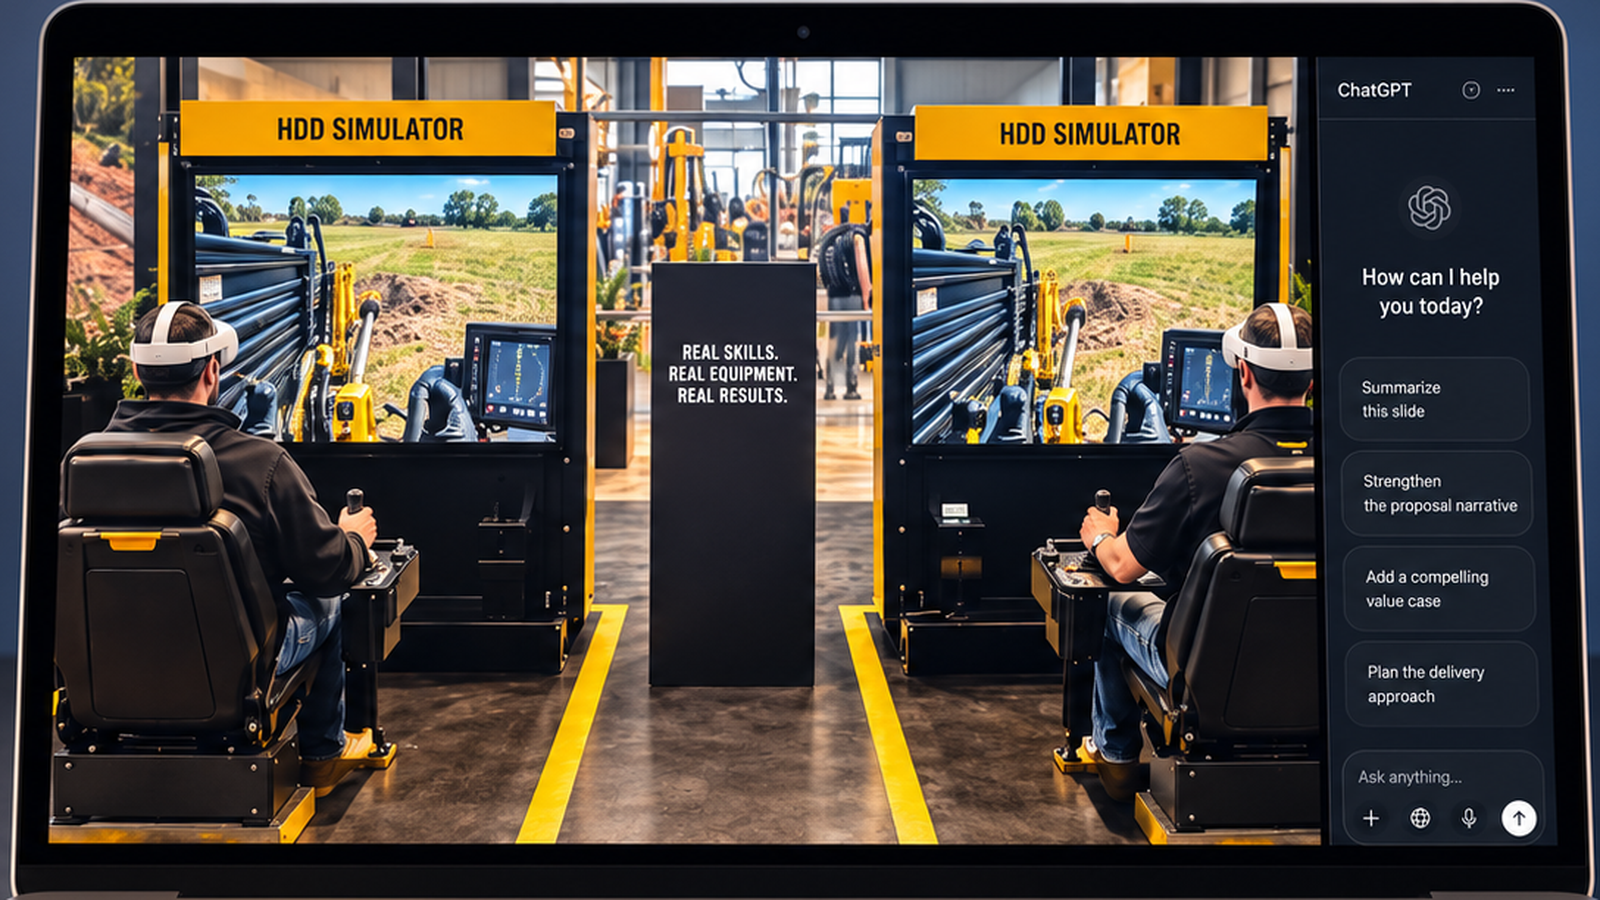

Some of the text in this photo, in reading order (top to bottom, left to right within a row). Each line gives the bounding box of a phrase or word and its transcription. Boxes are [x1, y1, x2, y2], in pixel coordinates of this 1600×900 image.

[1338, 82, 1412, 97] ChatGPT
[278, 117, 463, 140] HDD SIMULATOR
[1001, 122, 1180, 145] HDD SIMULATOR
[1363, 267, 1499, 290] How can I help
[1380, 297, 1483, 319] you today?
[683, 344, 778, 360] REAL SKILLS.
[669, 366, 797, 382] REAL EQUIPMENT.
[678, 387, 787, 403] REAL RESULTS.
[1363, 381, 1440, 394] Summarize
[1363, 404, 1424, 418] this slide
[1364, 474, 1441, 491] Strengthen
[1364, 499, 1518, 515] the proposal narrative
[1366, 570, 1488, 586] Add a compelling
[1367, 594, 1441, 607] value case
[1369, 665, 1484, 682] Plan the delivery
[1368, 690, 1434, 706] approach
[1359, 770, 1461, 787] Ask anything...
